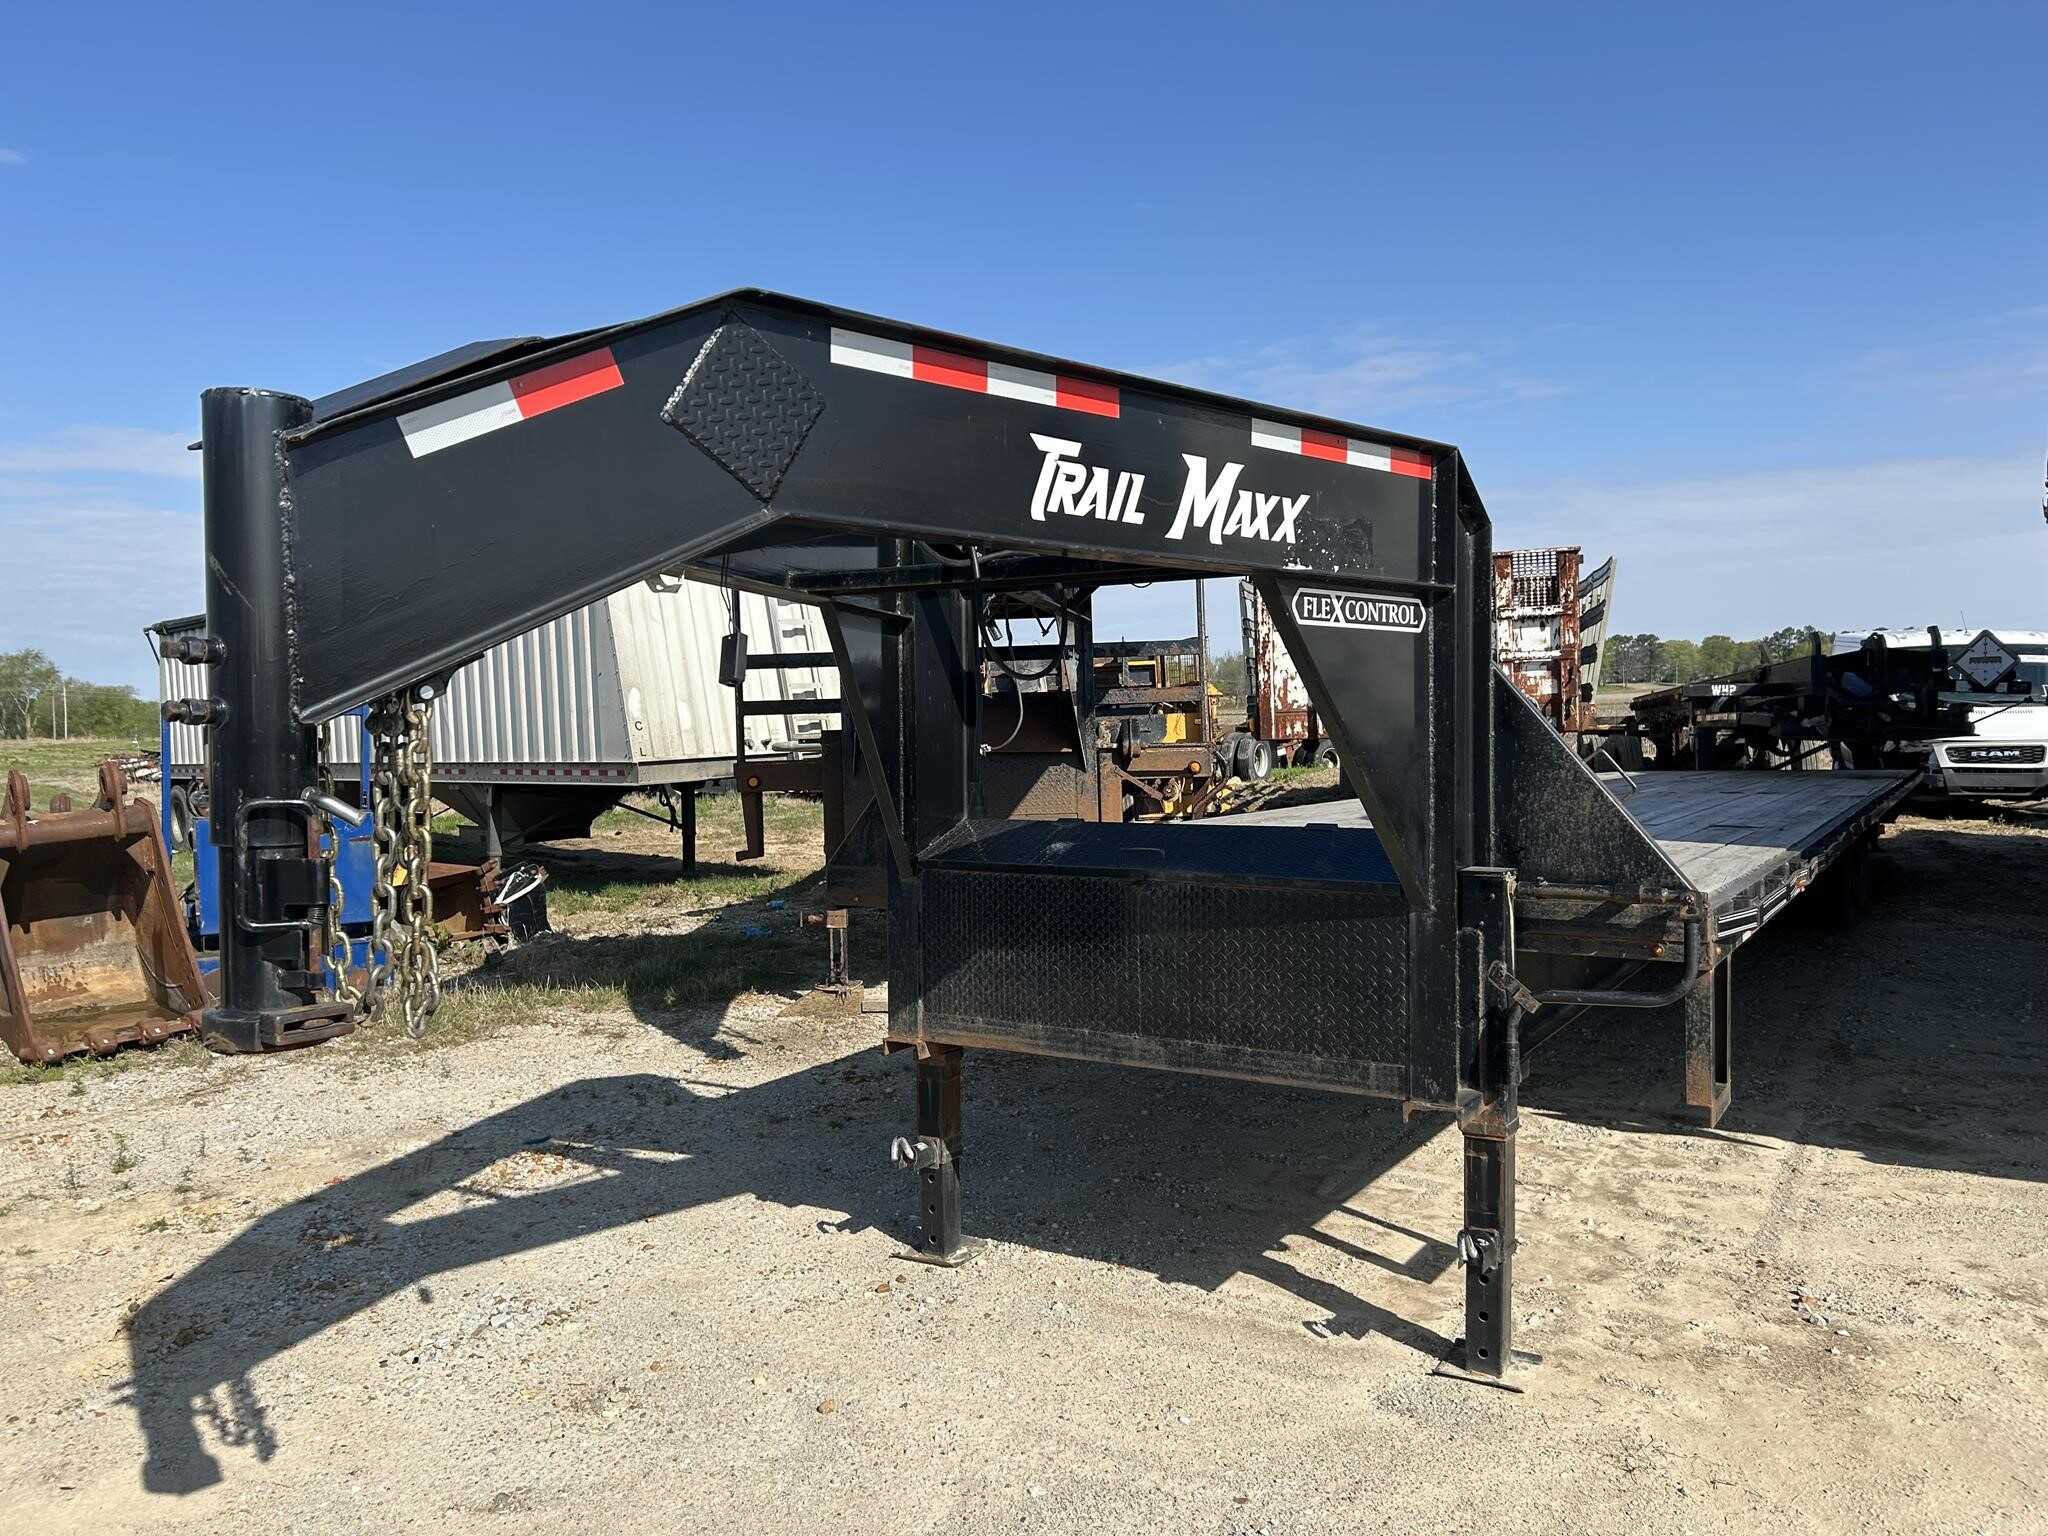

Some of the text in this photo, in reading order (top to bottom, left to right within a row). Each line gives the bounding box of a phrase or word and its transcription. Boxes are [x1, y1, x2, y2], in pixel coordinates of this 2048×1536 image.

[1029, 433, 1311, 545] TRAIL MAXX
[1303, 594, 1419, 625] FLEXCONTROL
